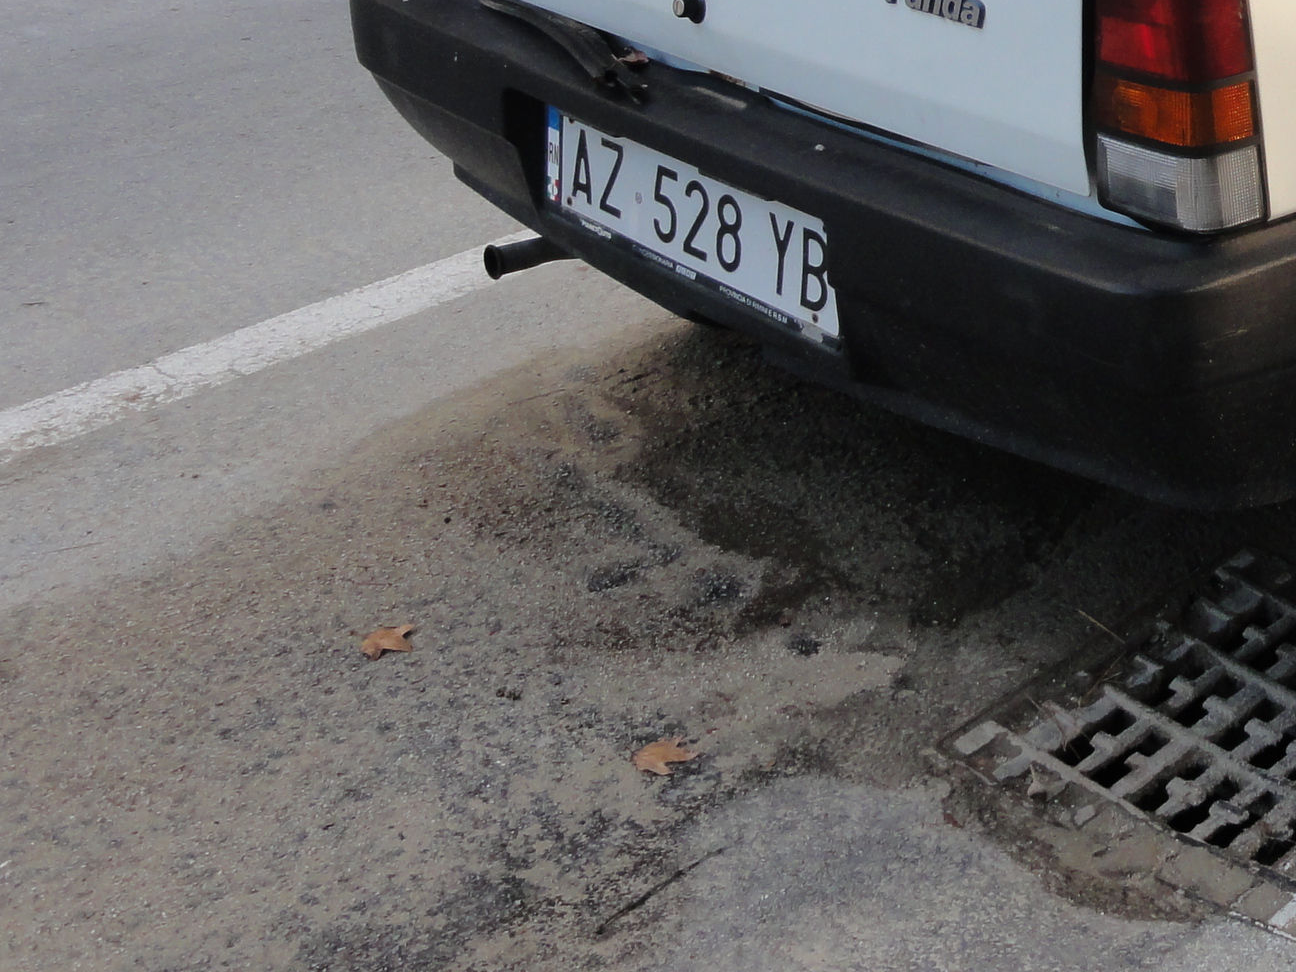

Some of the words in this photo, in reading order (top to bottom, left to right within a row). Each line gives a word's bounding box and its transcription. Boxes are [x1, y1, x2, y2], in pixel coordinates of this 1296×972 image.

[548, 141, 559, 166] RN
[571, 129, 624, 219] AZ
[653, 164, 743, 273] 528
[769, 212, 829, 312] YB
